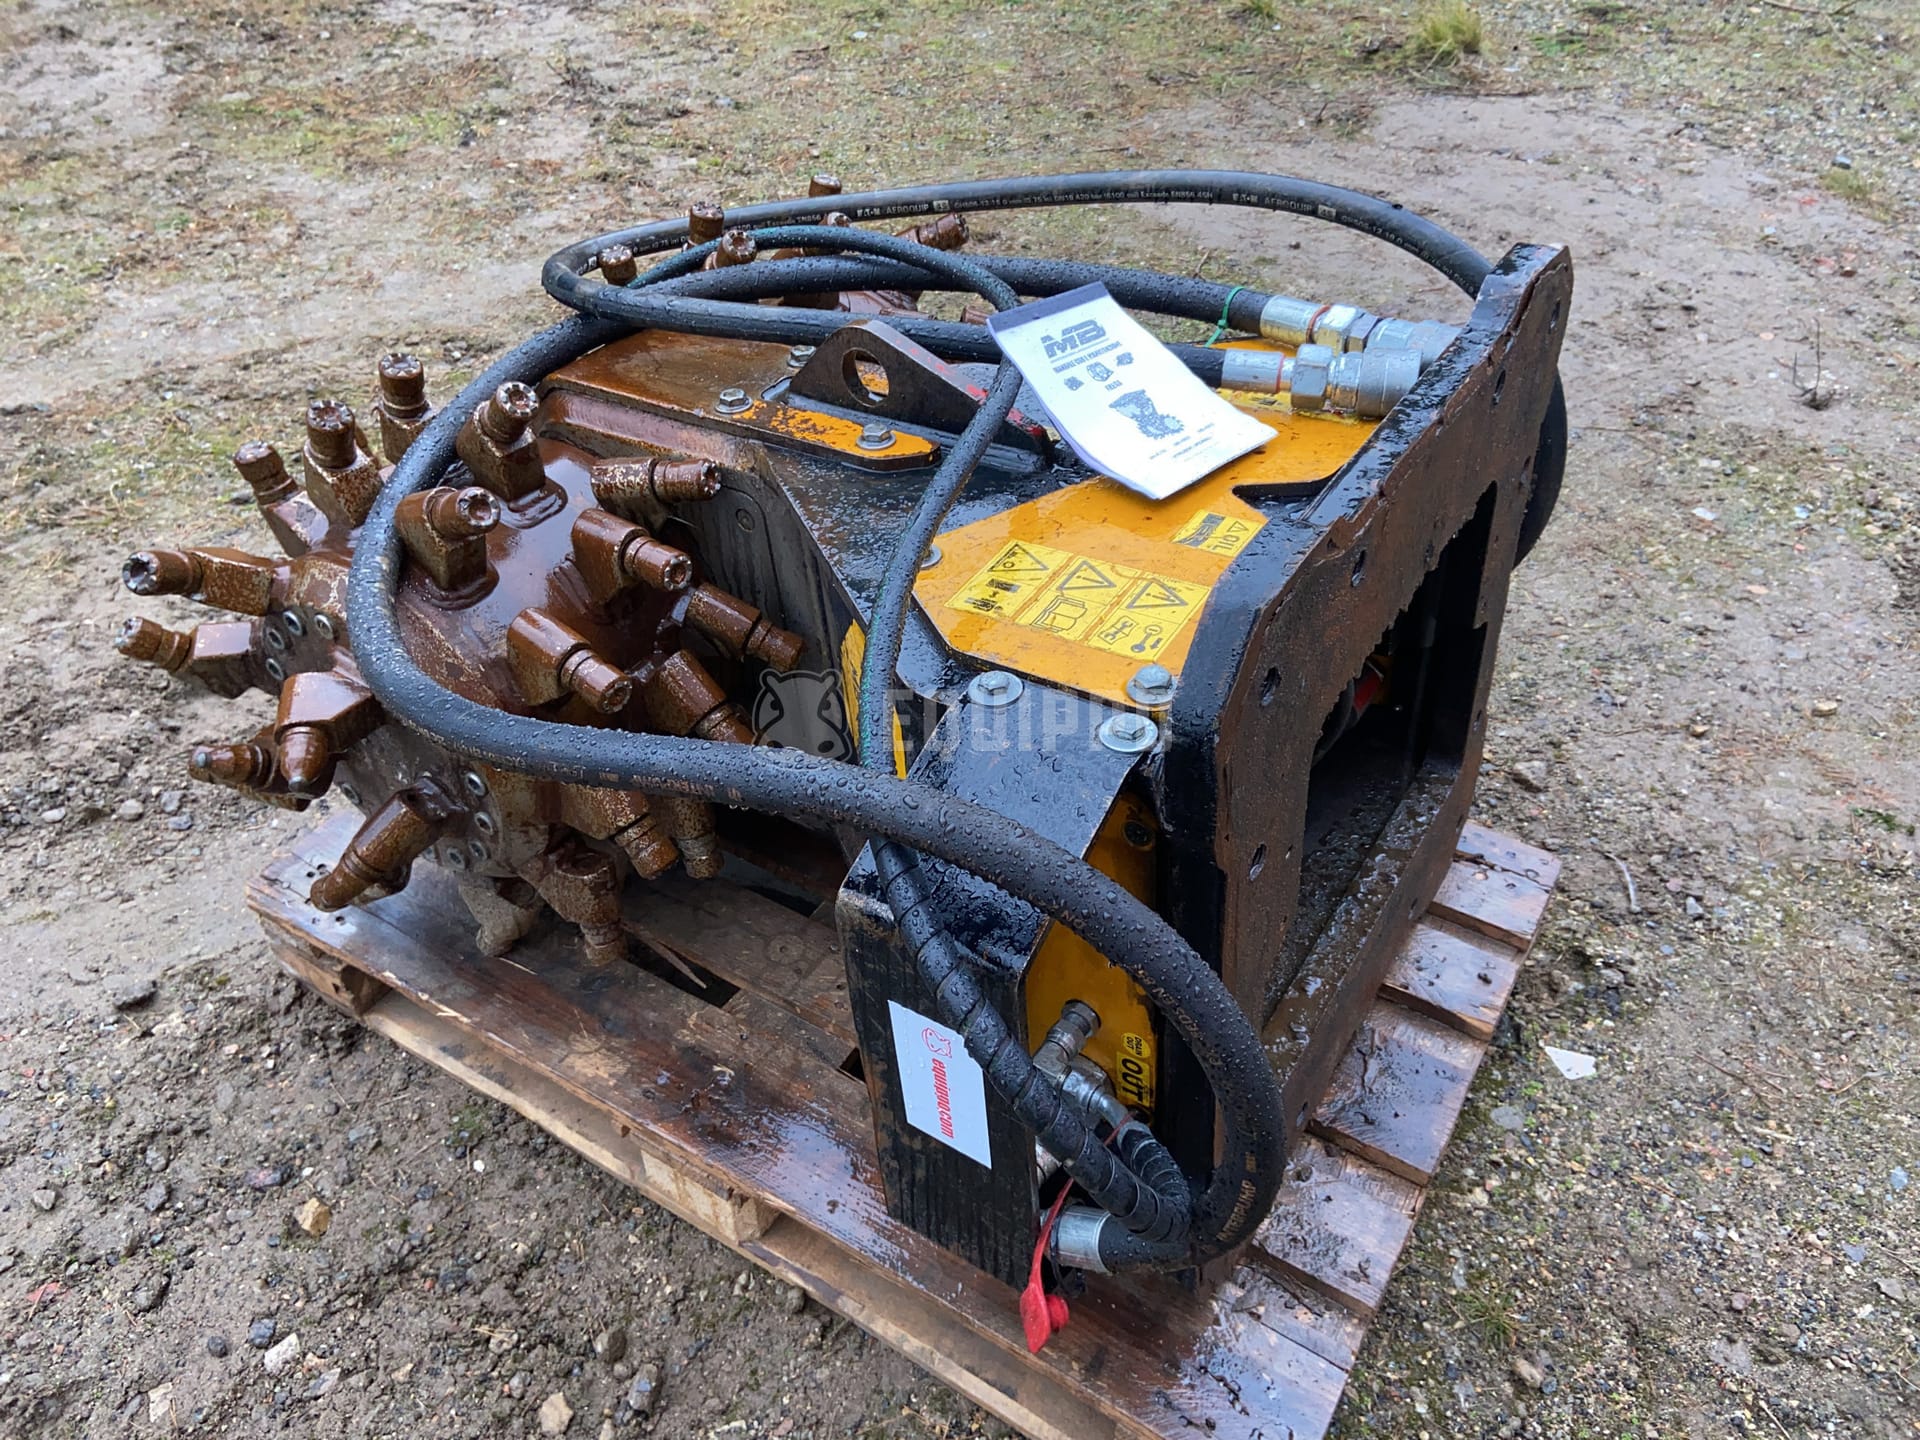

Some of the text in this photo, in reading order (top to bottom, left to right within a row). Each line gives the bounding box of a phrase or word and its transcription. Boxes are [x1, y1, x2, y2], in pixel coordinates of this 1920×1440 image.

[886, 204, 929, 215] AEROQUIP
[1264, 197, 1313, 213] AEROQUIP
[1040, 319, 1107, 359] MB
[1211, 534, 1241, 551] OIL
[1126, 1036, 1135, 1050] OUT
[1121, 1057, 1144, 1103] OUT
